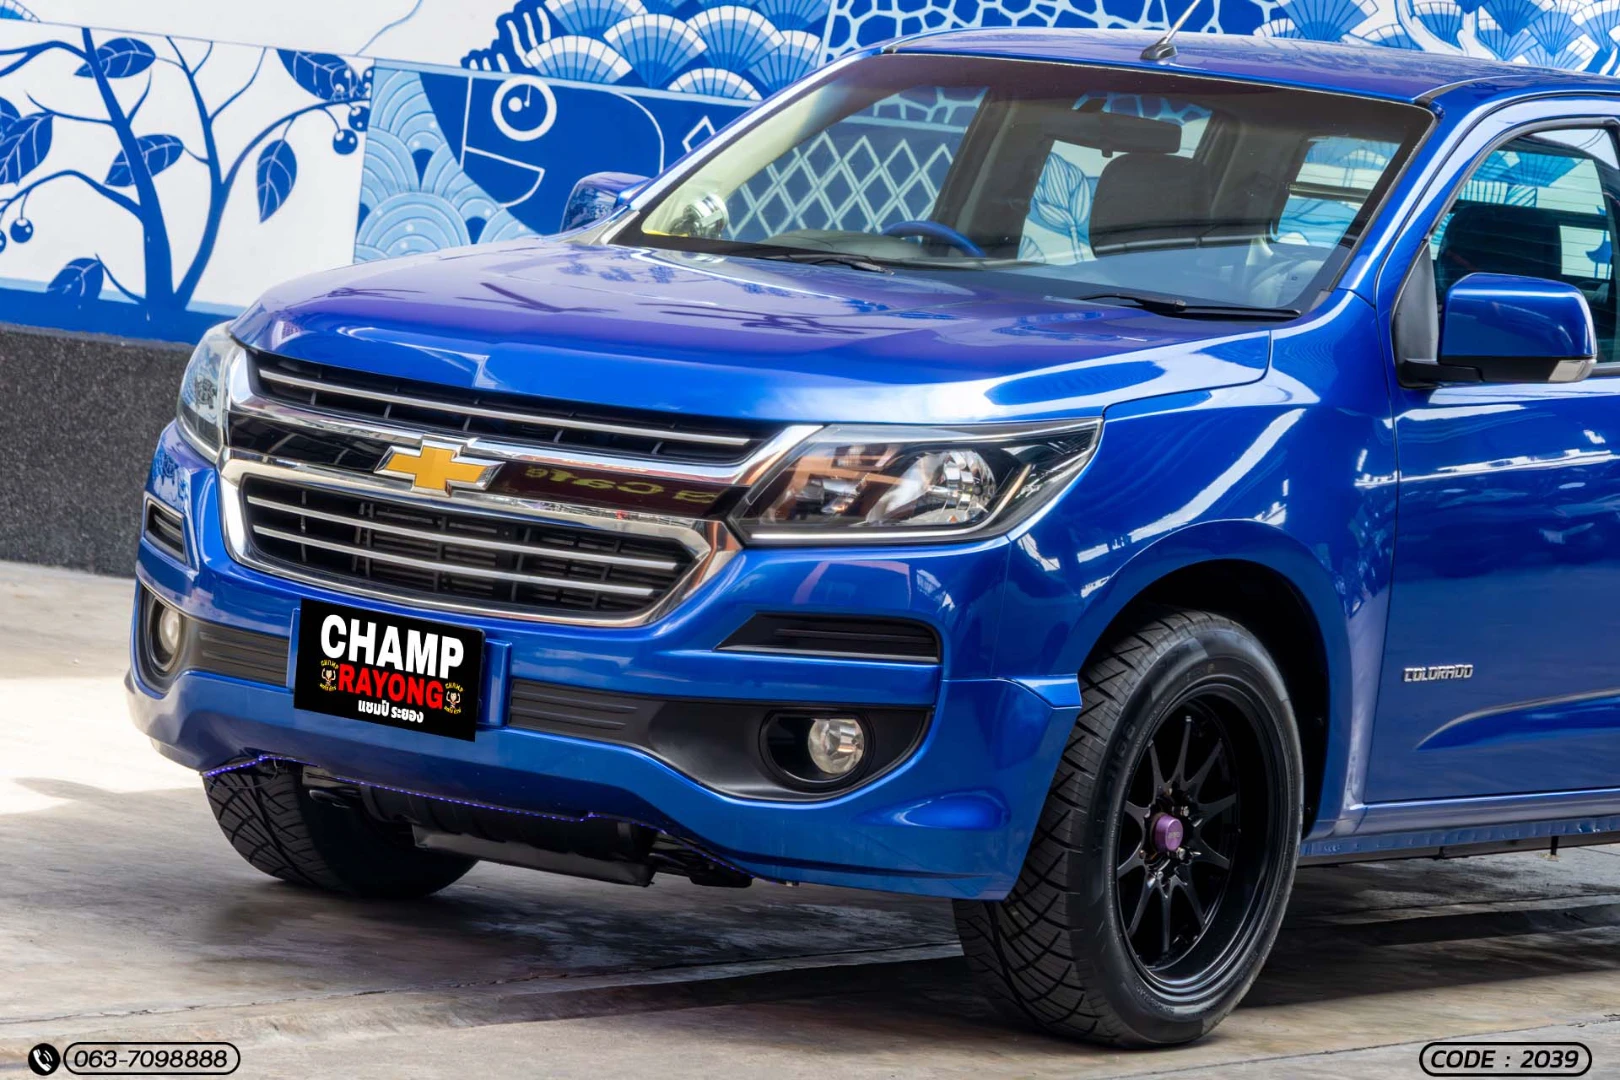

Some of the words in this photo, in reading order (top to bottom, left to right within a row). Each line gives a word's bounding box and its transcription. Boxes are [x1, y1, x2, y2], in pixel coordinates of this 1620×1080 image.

[320, 614, 464, 680] CHAMP
[338, 663, 444, 710] RAYONG
[1403, 664, 1474, 683] COLORADO
[391, 706, 424, 723] ระยอง
